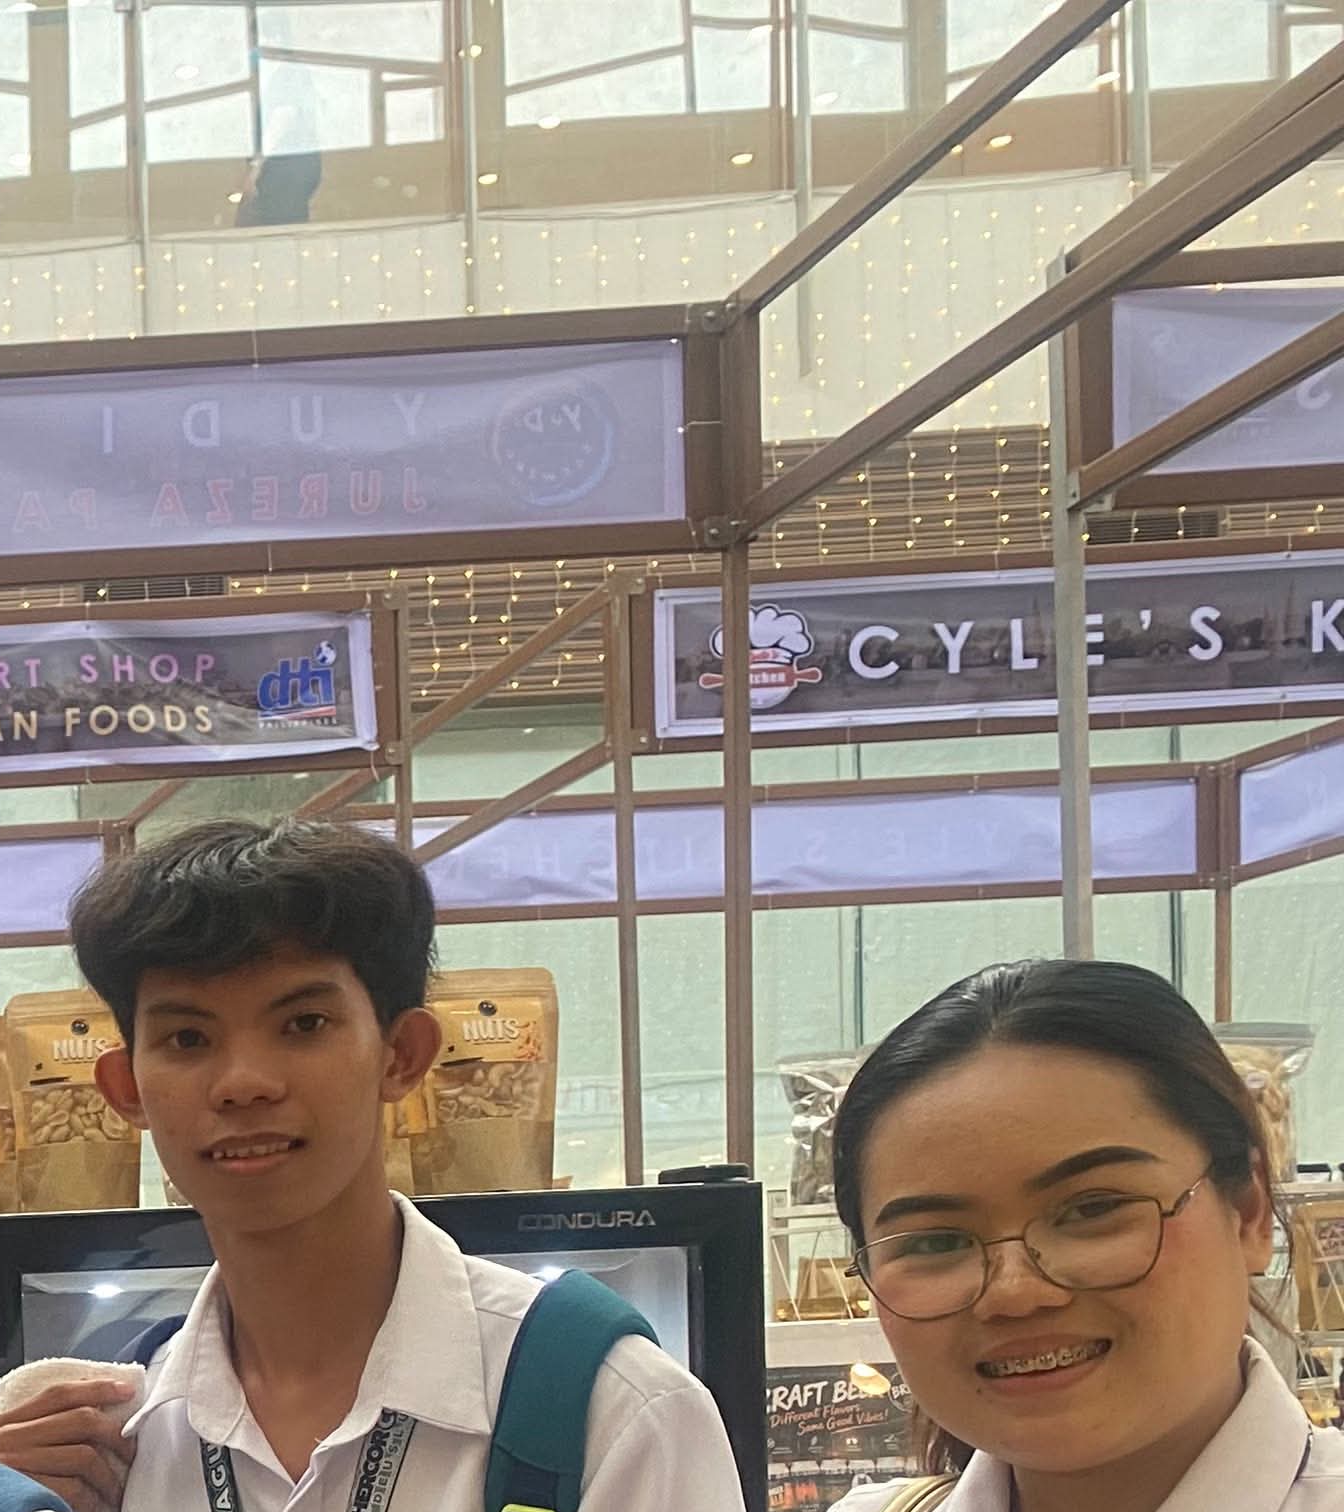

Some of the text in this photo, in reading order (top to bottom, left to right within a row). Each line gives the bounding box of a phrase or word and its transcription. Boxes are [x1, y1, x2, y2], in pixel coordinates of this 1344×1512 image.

[848, 607, 1224, 680] CYLE'S
[80, 653, 216, 684] SHOP
[65, 704, 212, 737] FOODS
[463, 1018, 520, 1042] NUTS
[518, 1209, 656, 1232] CONDURA
